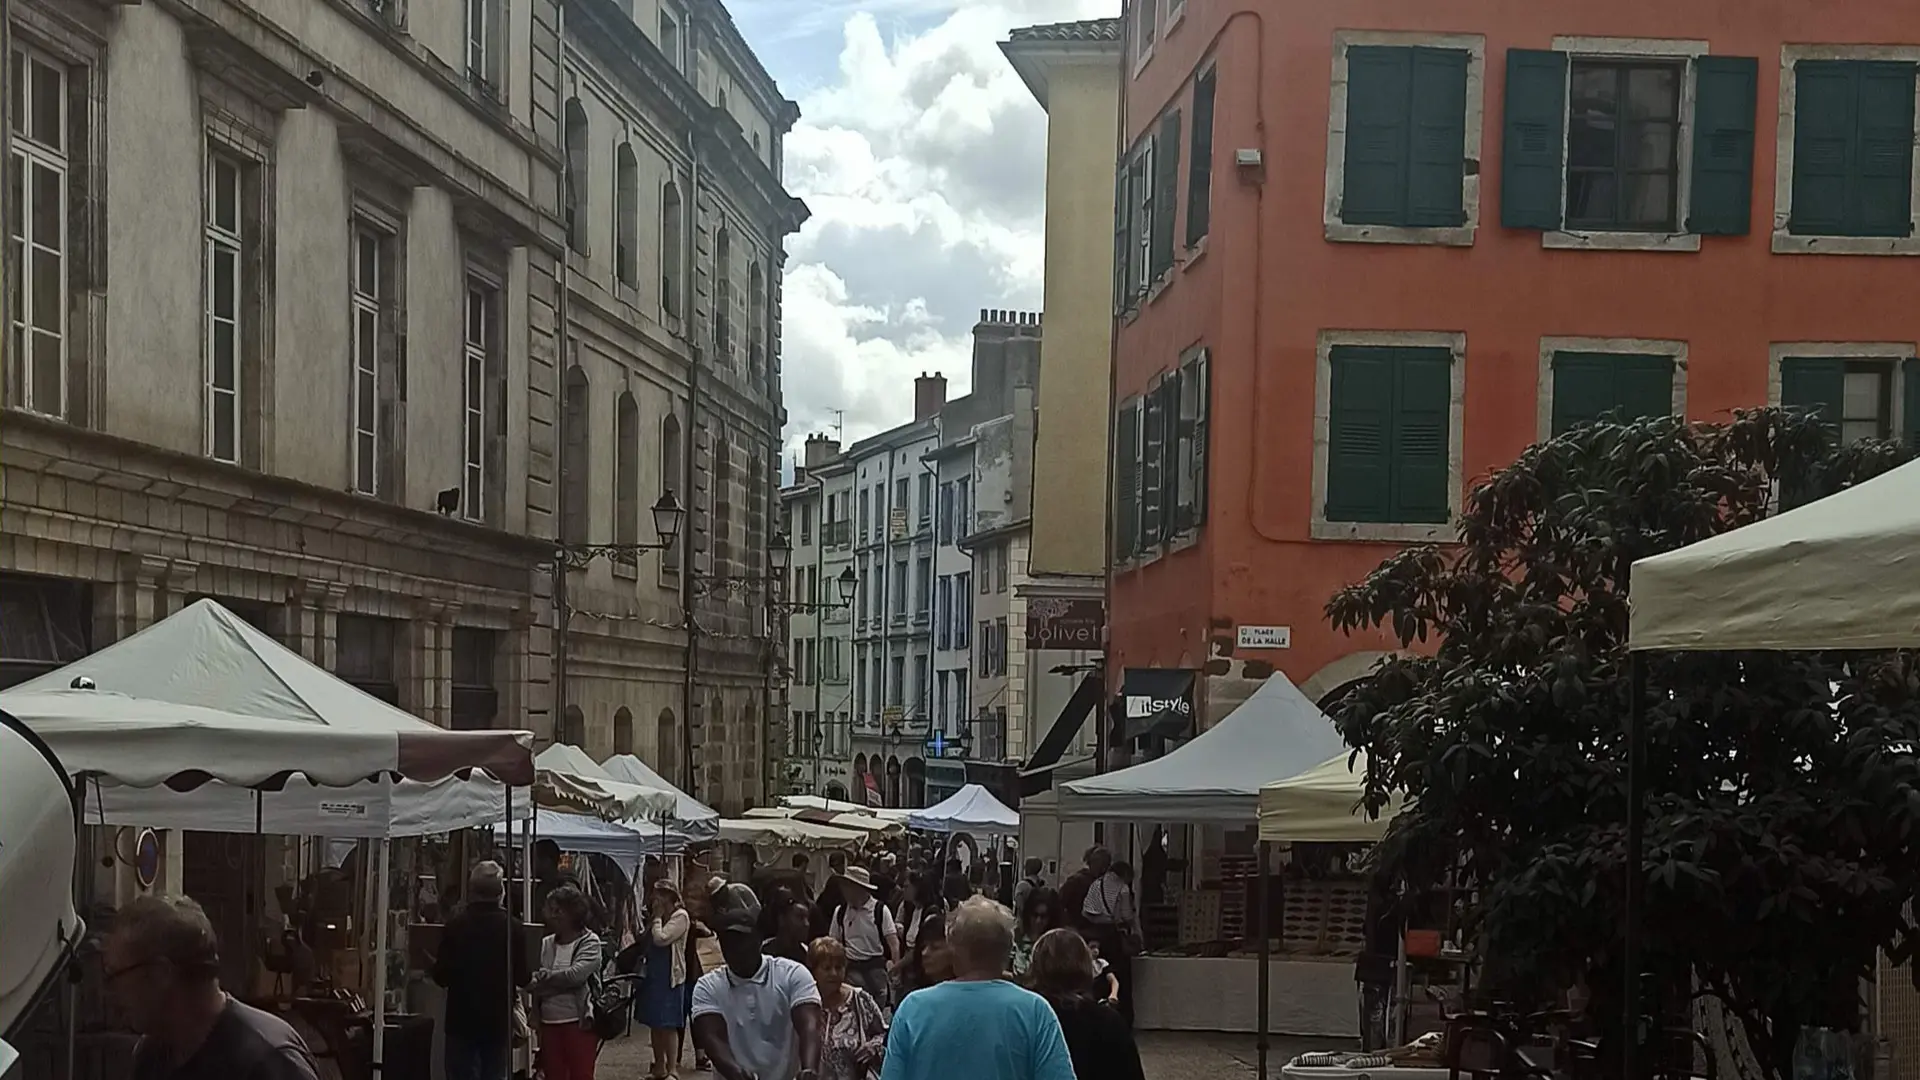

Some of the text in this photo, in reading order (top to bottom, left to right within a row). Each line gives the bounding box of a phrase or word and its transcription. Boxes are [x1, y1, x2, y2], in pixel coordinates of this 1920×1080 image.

[1027, 624, 1099, 641] Jolivet
[1241, 637, 1251, 645] DE
[1265, 637, 1286, 645] HALLE
